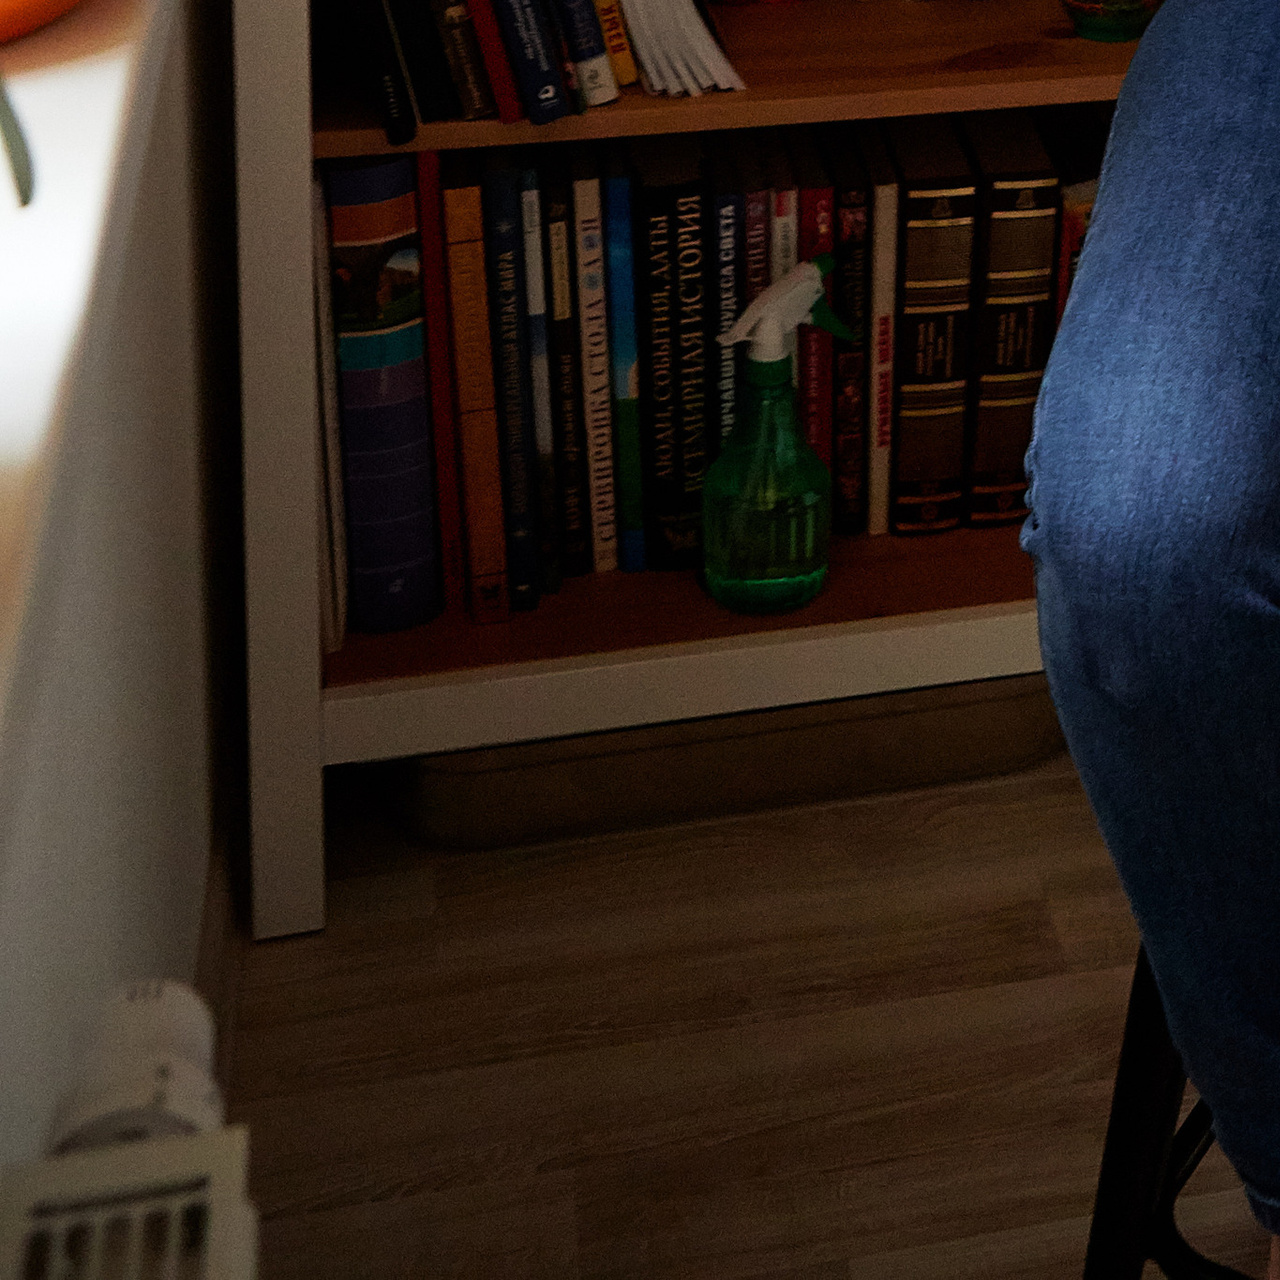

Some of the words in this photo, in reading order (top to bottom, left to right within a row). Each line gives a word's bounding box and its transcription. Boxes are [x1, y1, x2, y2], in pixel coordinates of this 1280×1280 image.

[603, 3, 627, 55] ЯЗЫК
[497, 250, 515, 291] МИРА
[648, 214, 671, 280] ДАТЫ
[676, 194, 704, 326] ИСТОРИЯ
[718, 204, 736, 262] СВЕТА
[499, 294, 518, 340] АТЛАС
[585, 298, 607, 376] СТОЛА
[651, 284, 676, 401] СОБЫТИЯ,
[655, 405, 678, 481] ЛЮДИ,
[679, 329, 707, 494] ВСЕМИРНАЯ
[592, 385, 617, 542] СЕРВИРОВКА
